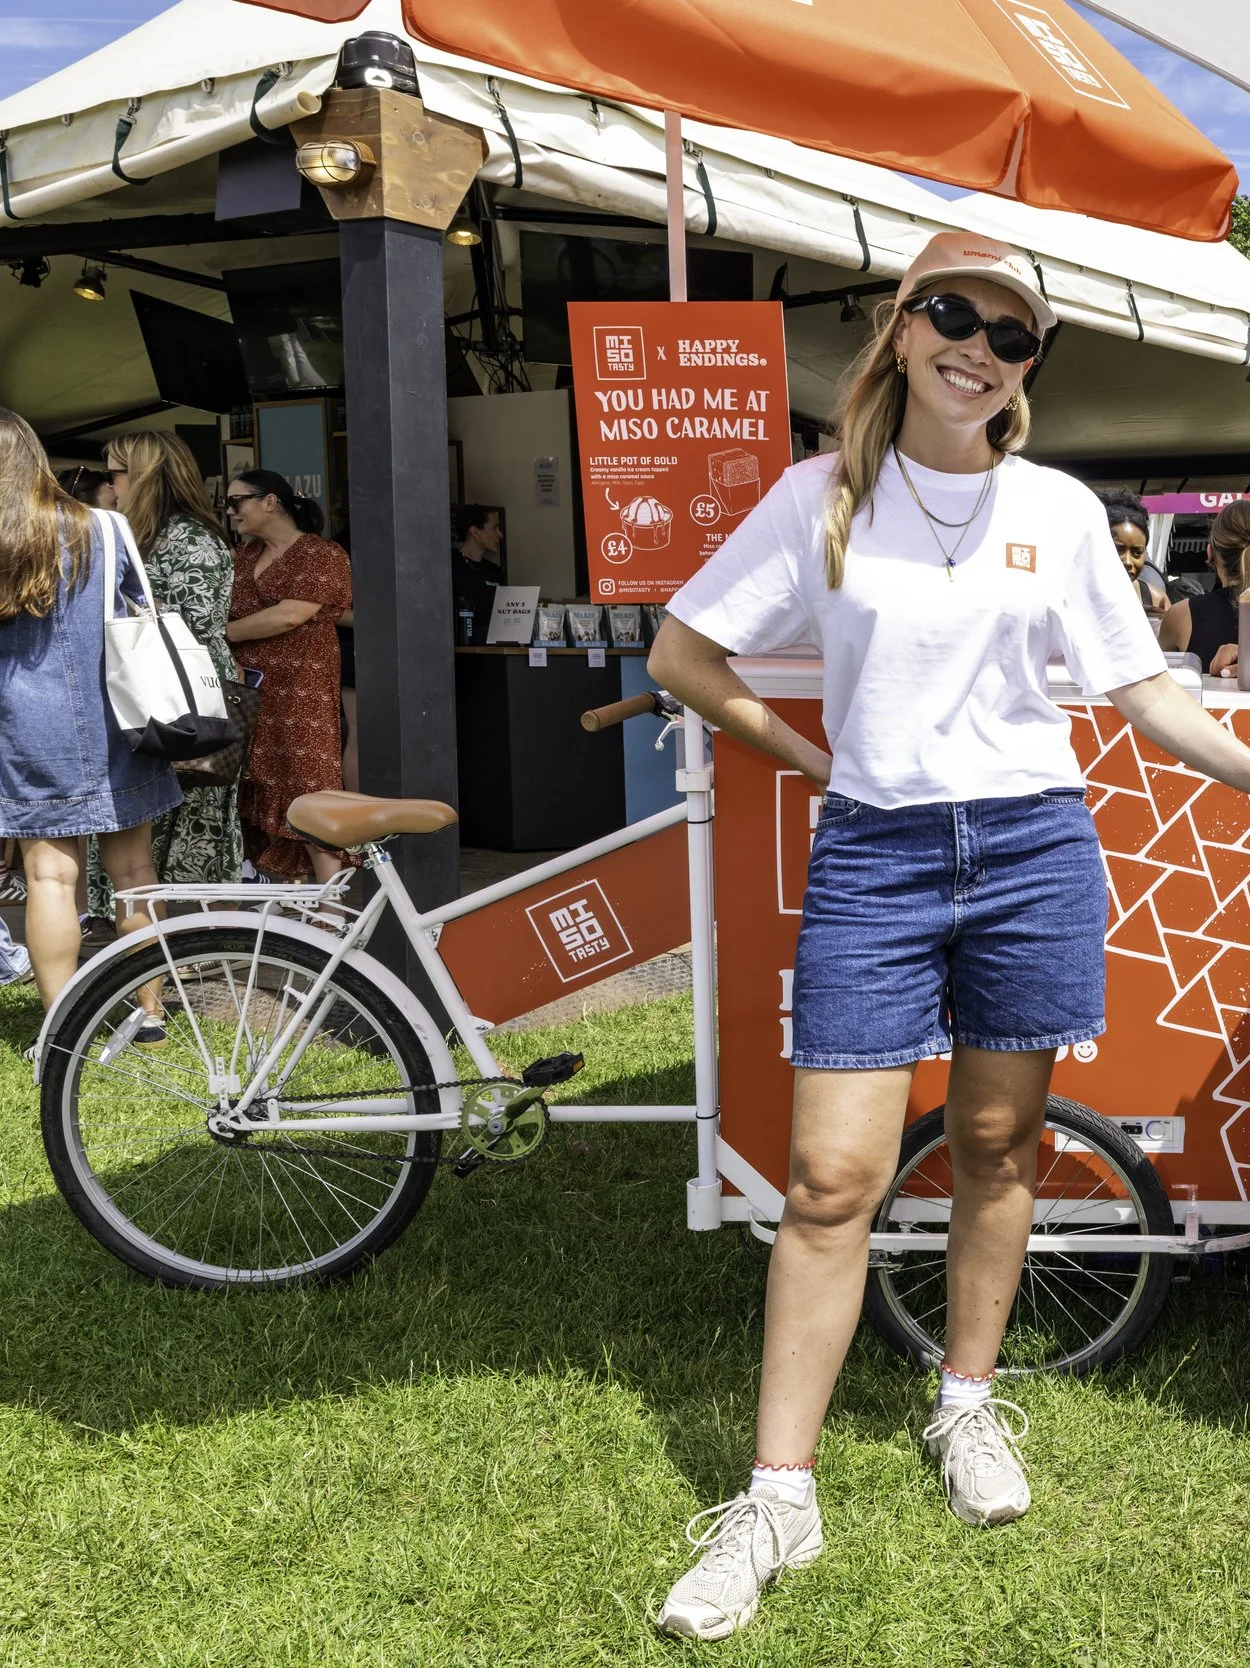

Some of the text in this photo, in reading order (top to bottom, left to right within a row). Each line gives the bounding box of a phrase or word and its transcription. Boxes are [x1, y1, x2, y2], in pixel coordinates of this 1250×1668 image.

[677, 339, 740, 353] HAPPY
[608, 363, 634, 372] TASTY
[594, 388, 770, 413] YOU HAD ME AT
[599, 416, 770, 442] MISO CARAMEL
[589, 456, 678, 465] LITTLE POT OF GOLD
[695, 505, 715, 518] £5
[705, 533, 723, 542] THE
[607, 540, 628, 557] £4
[568, 939, 610, 963] TASTY
